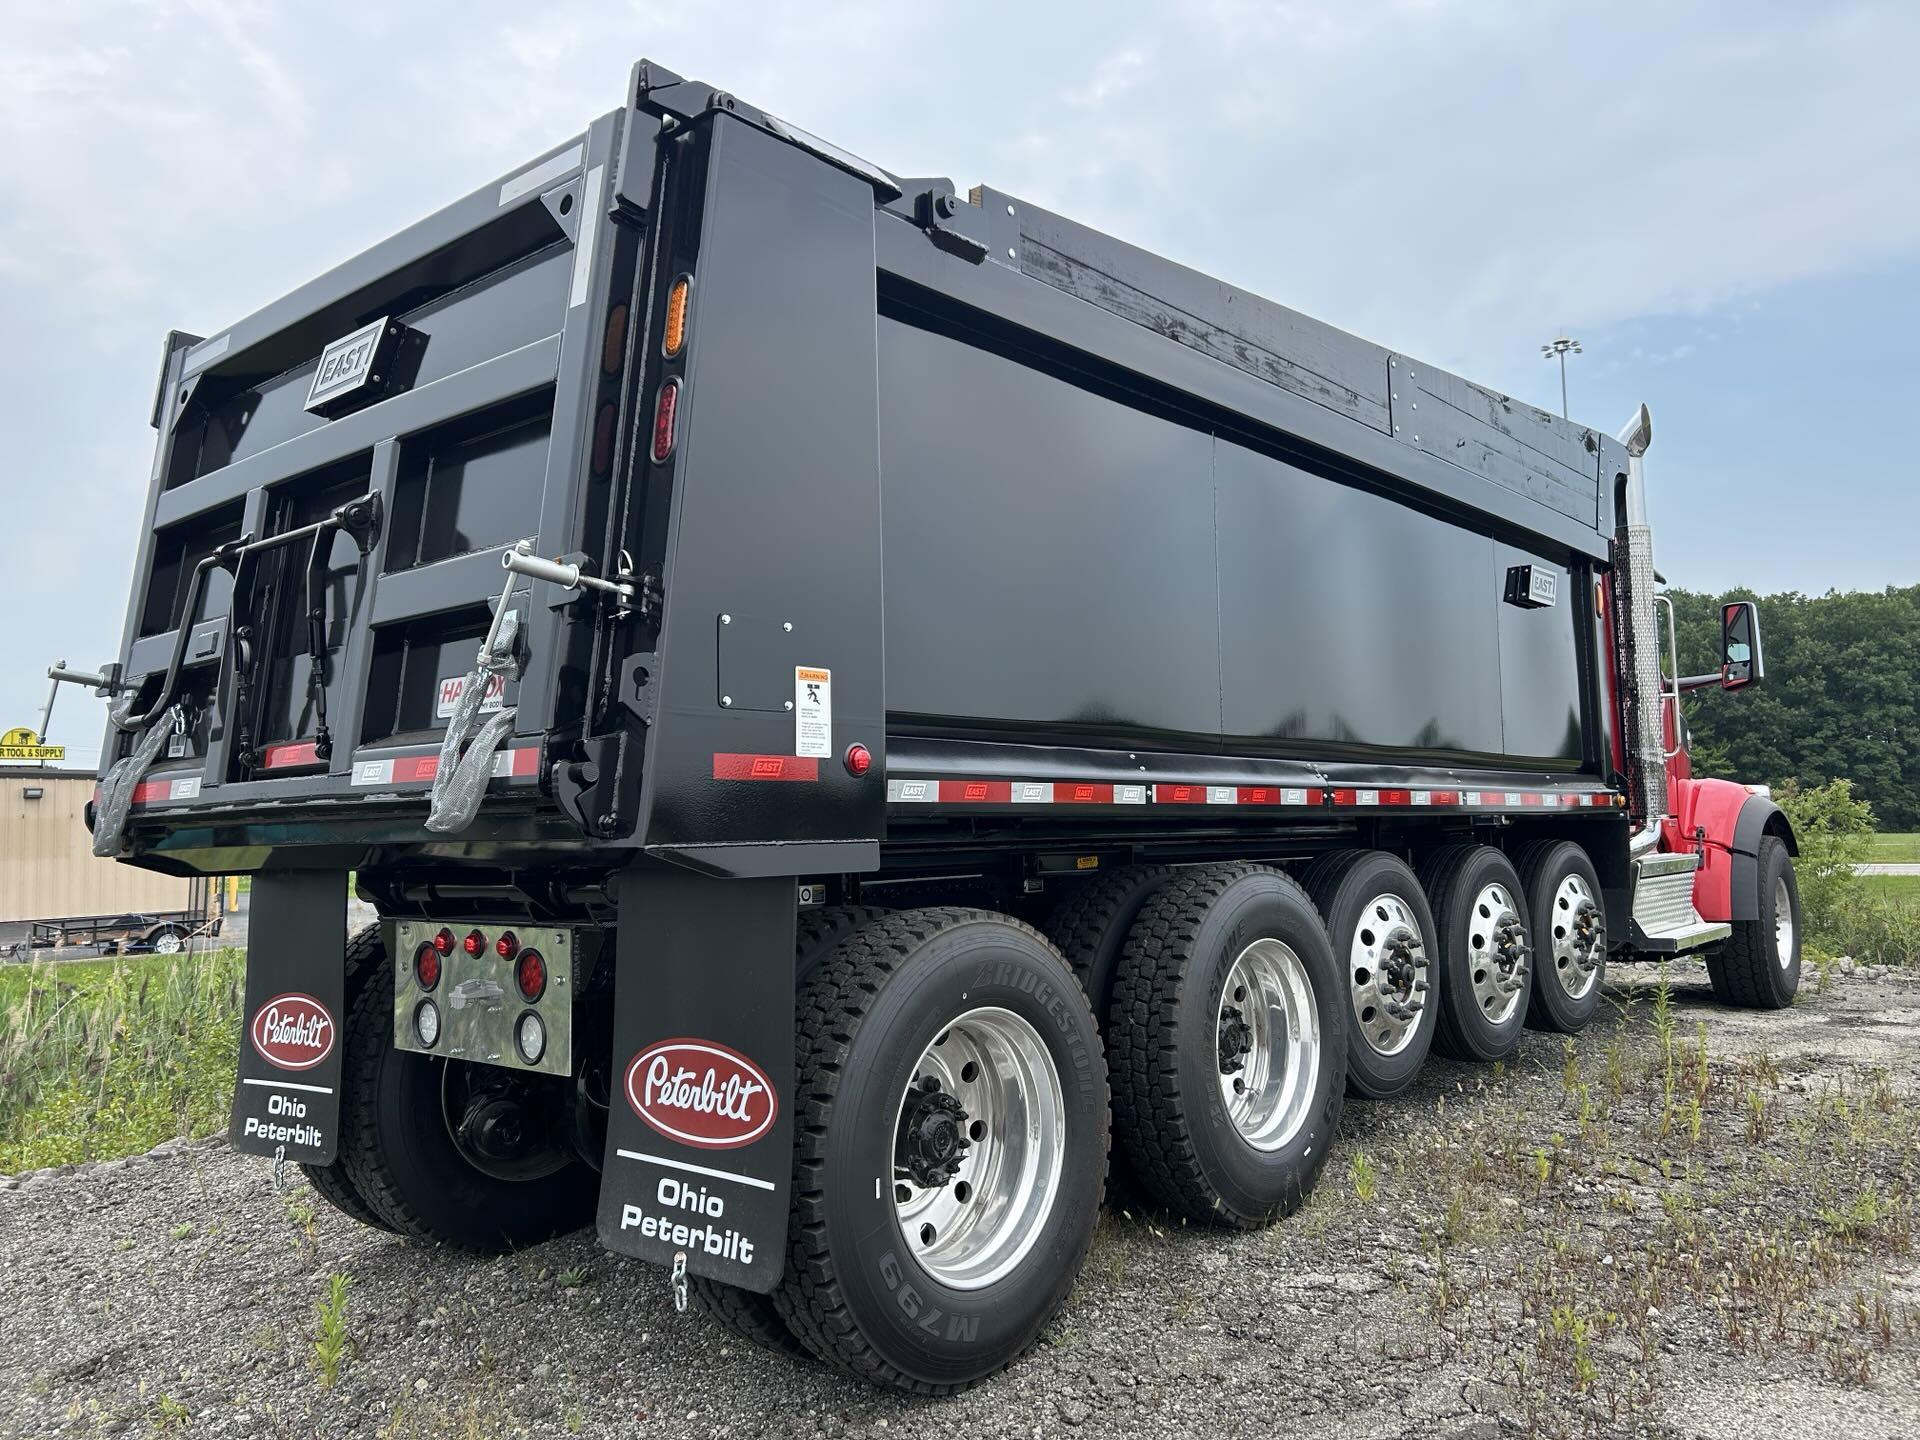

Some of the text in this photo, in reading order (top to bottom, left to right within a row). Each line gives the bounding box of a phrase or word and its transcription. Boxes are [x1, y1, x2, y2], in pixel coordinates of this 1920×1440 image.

[320, 342, 370, 386] EAST
[1534, 575, 1553, 594] EAST
[441, 676, 505, 704] HAOX
[6, 748, 26, 757] TOOL
[27, 748, 33, 757] &
[35, 748, 63, 757] SUPPLY
[365, 766, 381, 778] EAST
[419, 762, 436, 774] EAST
[756, 762, 779, 773] EAST
[904, 786, 923, 796] EAST
[967, 787, 985, 797] EAST
[1025, 788, 1040, 797] EAST
[1077, 789, 1092, 798] EAST
[1125, 790, 1139, 799] EAST
[263, 1007, 328, 1048] Peterbilt
[972, 959, 1096, 1115] BRIDGESTONE
[645, 1055, 763, 1122] Peterbilt
[268, 1094, 307, 1118] Ohio
[244, 1117, 322, 1148] Peterbilt
[657, 1178, 724, 1238] Ohio
[620, 1204, 755, 1265] Peterbilt
[879, 1250, 982, 1343] M799
